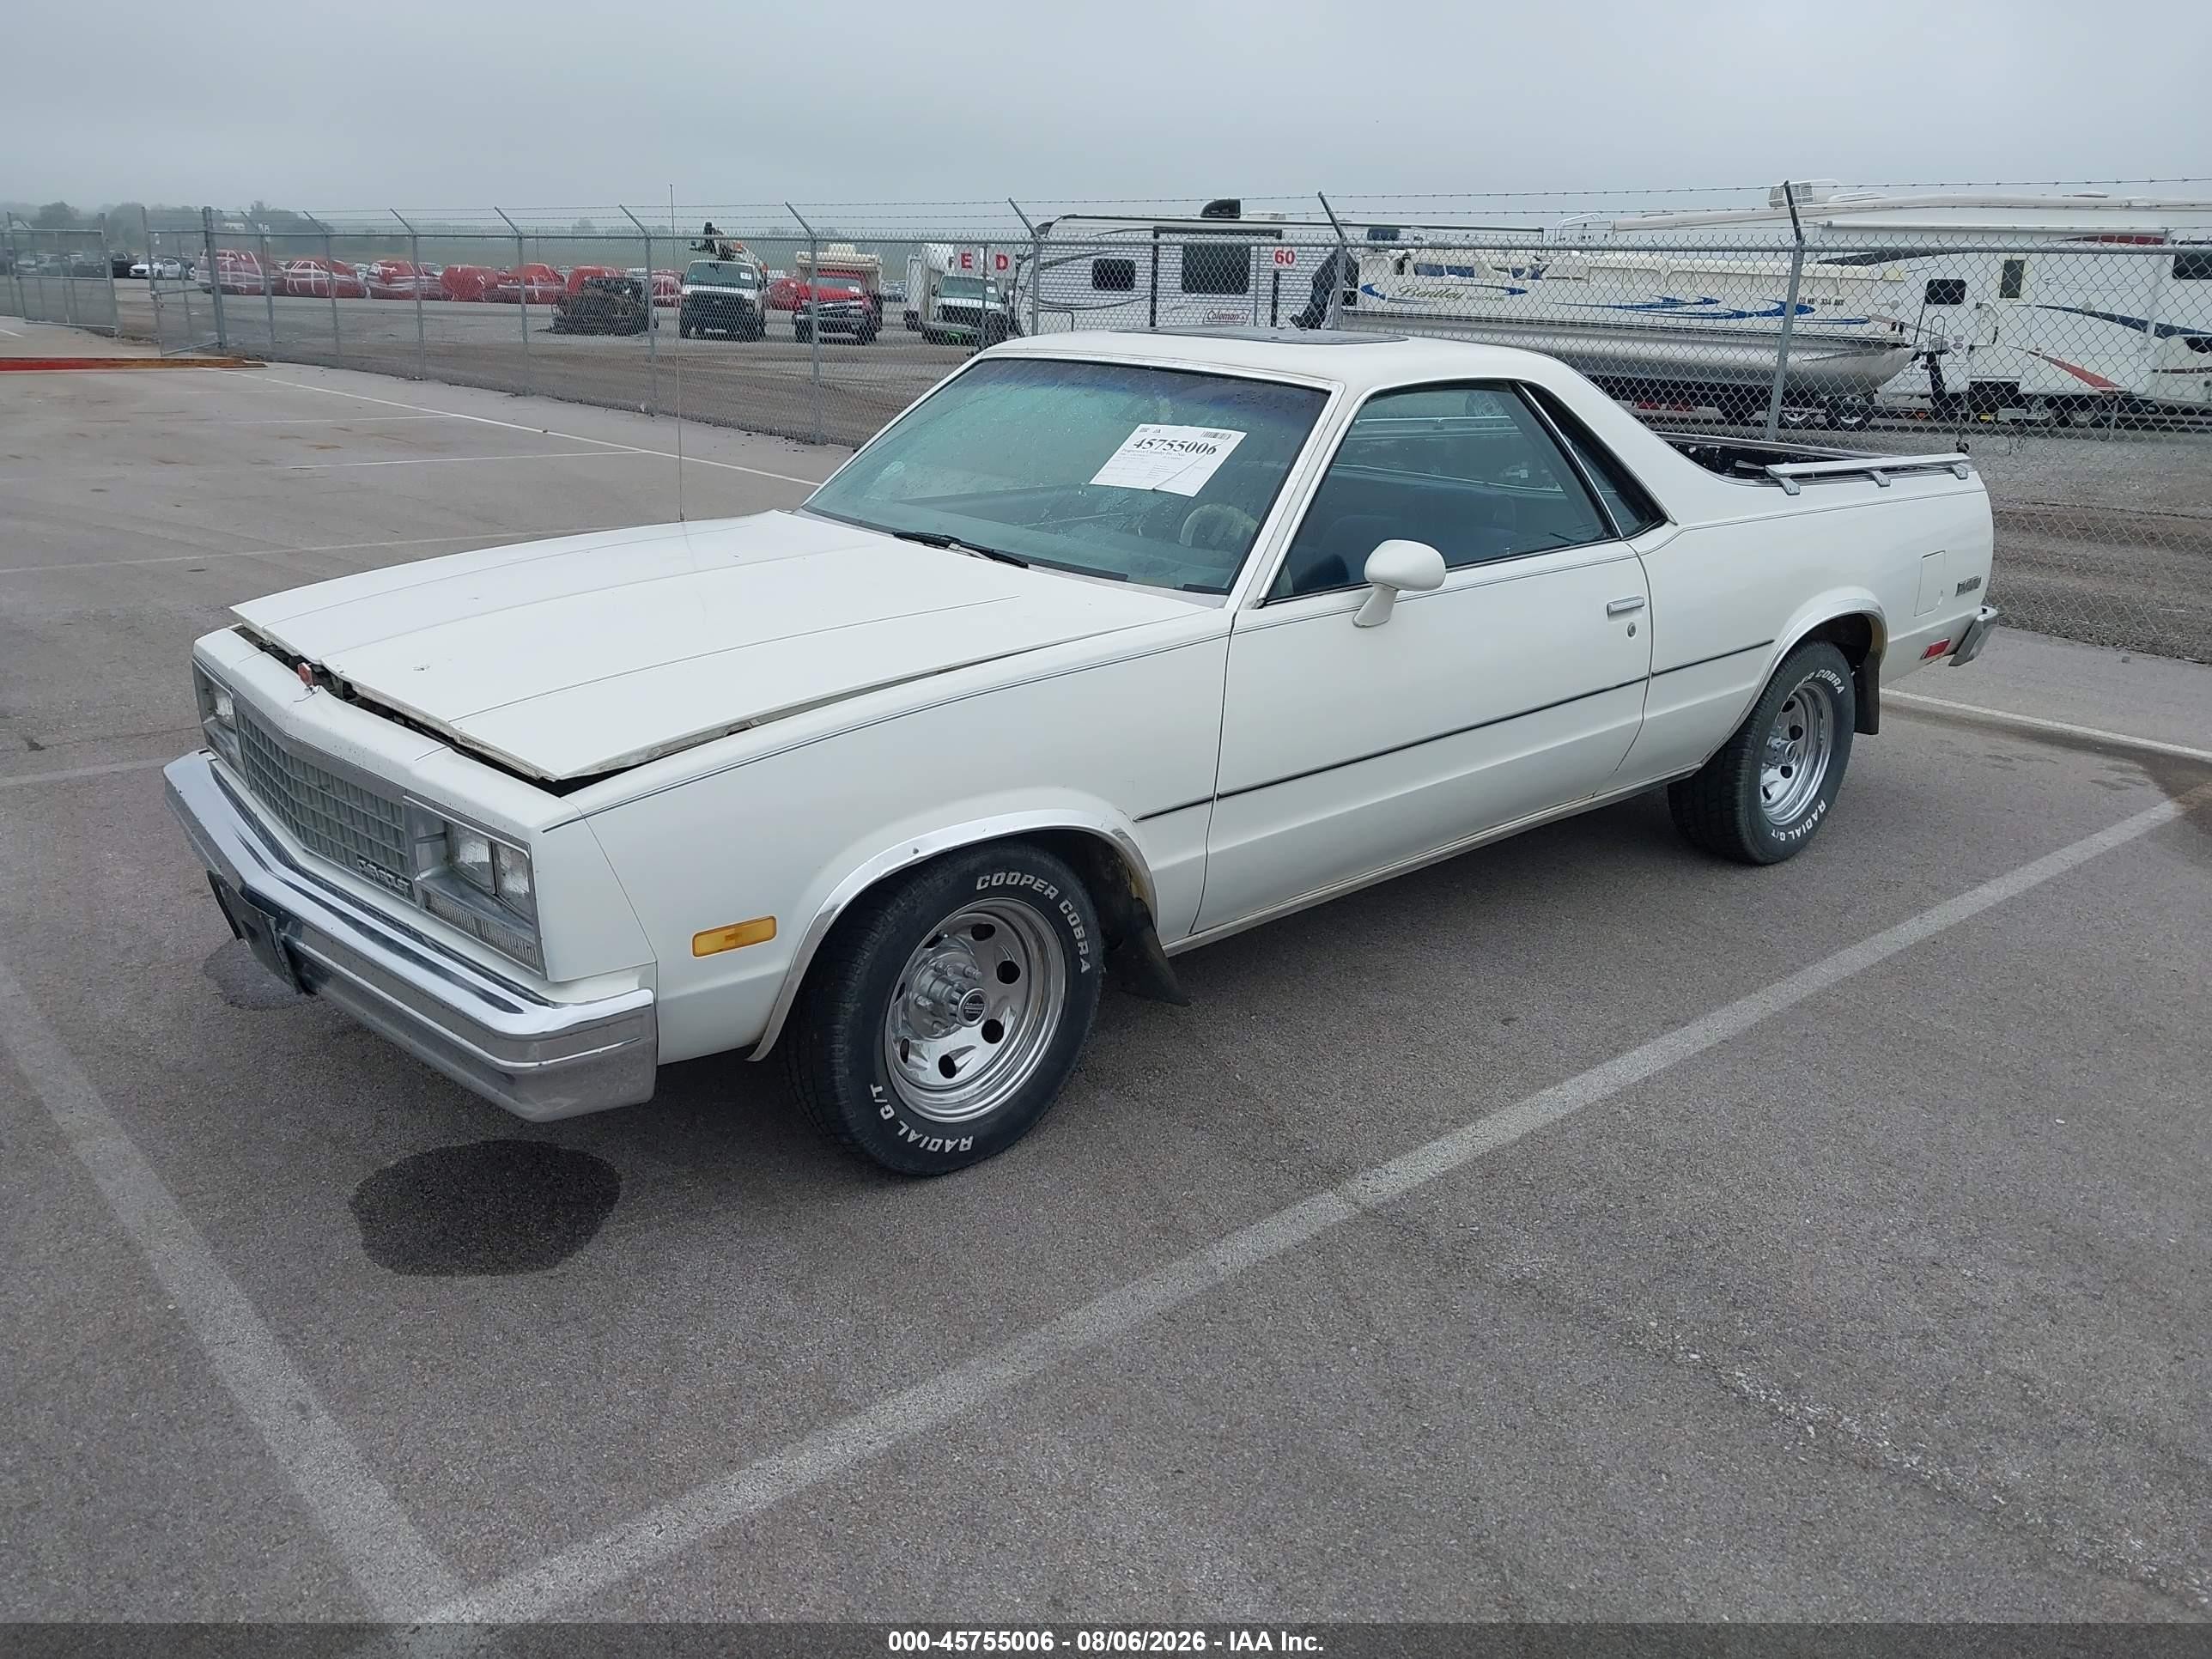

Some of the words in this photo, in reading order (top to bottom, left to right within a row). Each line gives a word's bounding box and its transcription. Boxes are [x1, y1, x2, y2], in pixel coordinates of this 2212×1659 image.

[960, 252, 973, 269] E
[995, 253, 1009, 270] D
[1274, 250, 1296, 264] 60
[1393, 284, 1465, 301] Bentley
[1206, 309, 1239, 321] Coleman
[1133, 437, 1221, 455] 45755006
[1814, 669, 1845, 694] COBRA
[1788, 799, 1826, 840] RADIAL
[975, 871, 1060, 900] COOPER
[1058, 898, 1091, 974] COBRA
[869, 1083, 895, 1121] G/T
[897, 1119, 974, 1153] RADIAL
